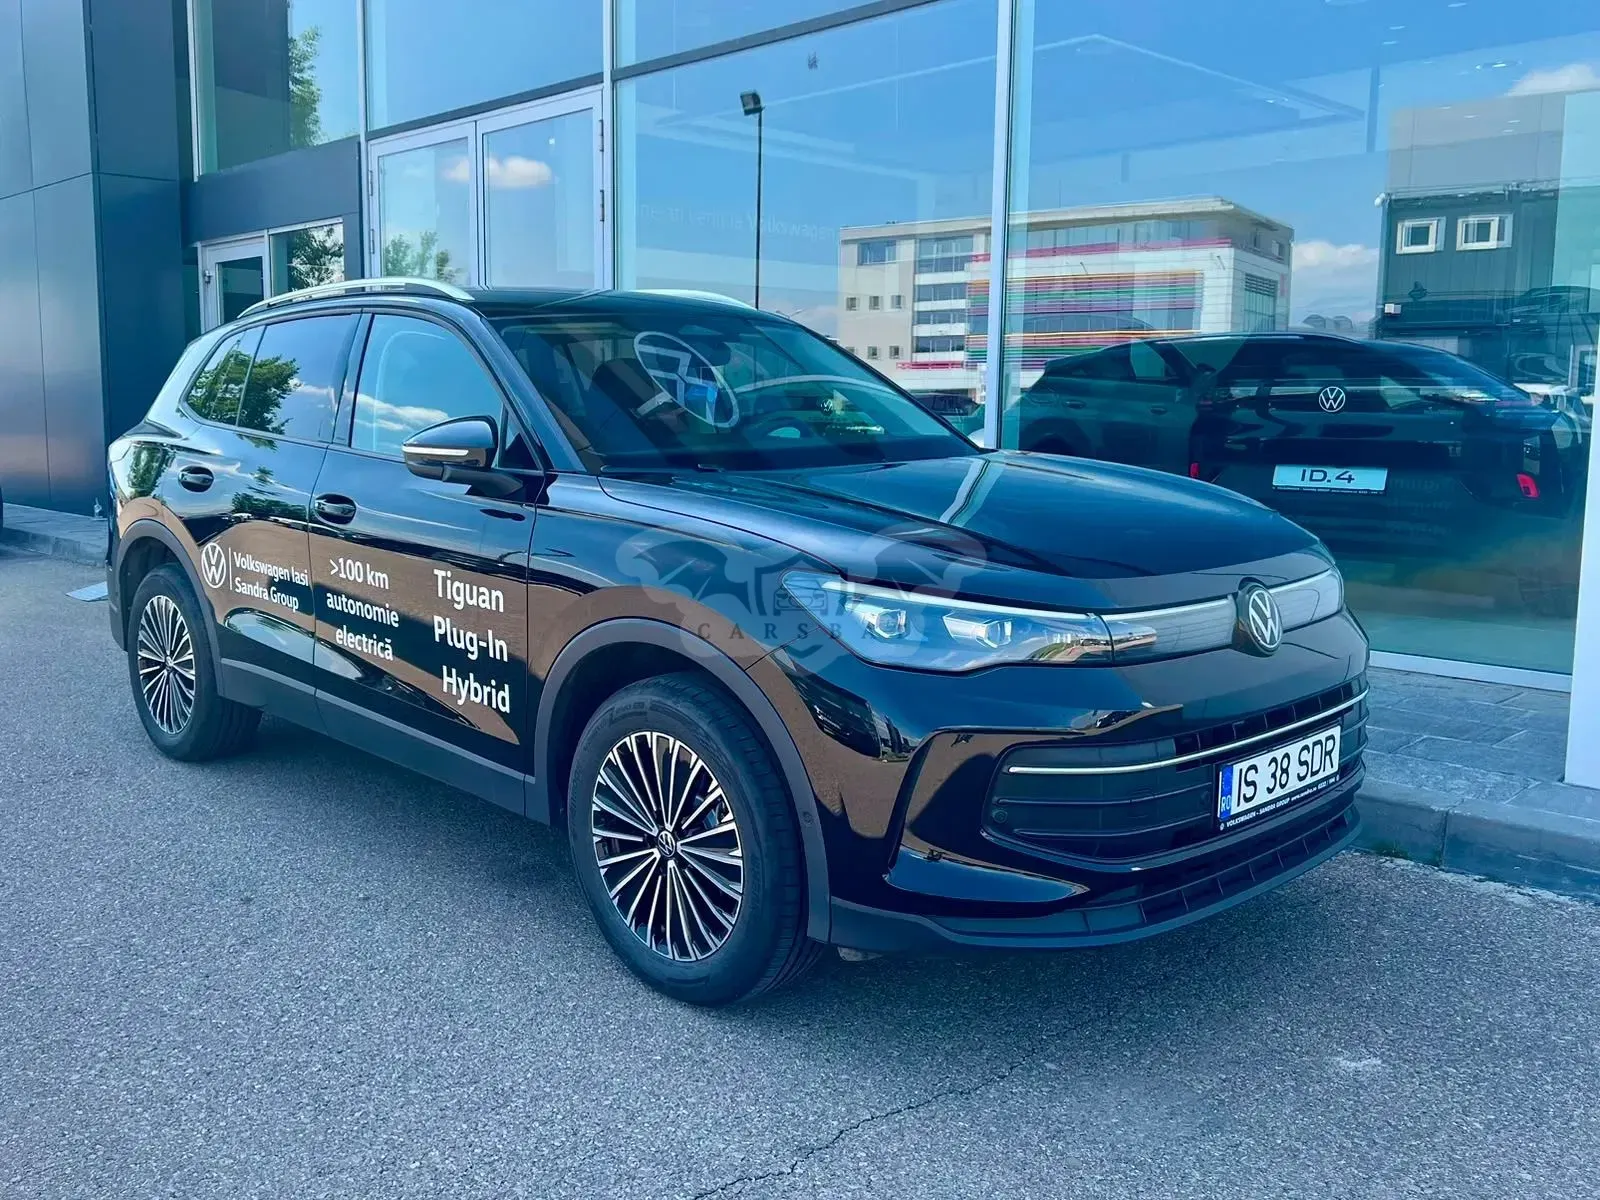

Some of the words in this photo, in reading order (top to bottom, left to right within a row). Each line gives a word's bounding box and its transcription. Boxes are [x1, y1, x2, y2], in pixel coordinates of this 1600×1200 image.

[233, 551, 290, 583] Volkswagen
[292, 568, 309, 587] Iasi
[329, 558, 364, 582] >100
[367, 565, 390, 590] km
[234, 576, 269, 600] Sandra
[270, 586, 299, 613] Group
[433, 568, 504, 613] Tiguan
[326, 591, 400, 628] autonomie
[335, 627, 394, 661] electrică
[433, 615, 509, 662] Plug-In
[442, 665, 510, 714] Hybrid
[1236, 764, 1258, 808] IS
[1266, 752, 1290, 794] 38
[1297, 734, 1336, 782] SDR
